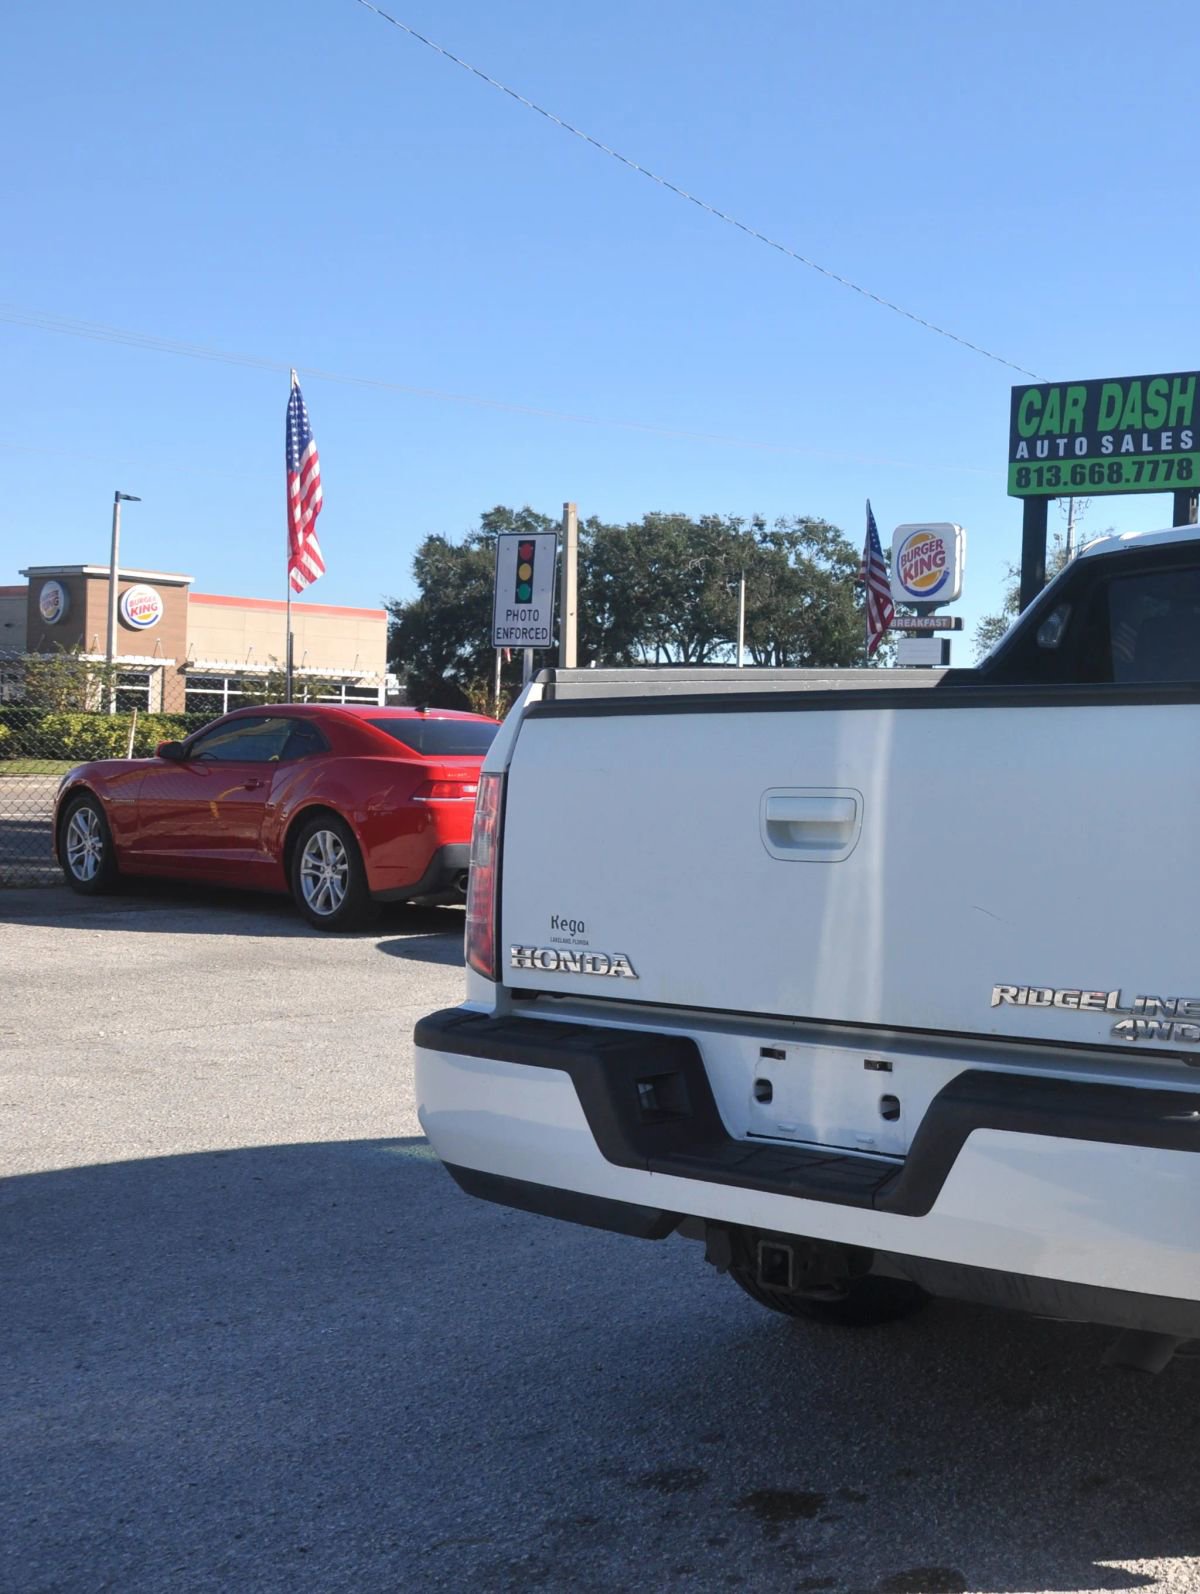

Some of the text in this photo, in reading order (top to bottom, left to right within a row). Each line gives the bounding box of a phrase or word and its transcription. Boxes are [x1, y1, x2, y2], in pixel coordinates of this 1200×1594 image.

[1017, 376, 1196, 438] CAR DASH
[1015, 430, 1193, 459] AUTO SALES
[1015, 458, 1193, 489] 813.668.7778
[900, 538, 944, 568] BURGER
[902, 550, 946, 586] KING
[130, 602, 158, 616] KING
[505, 609, 540, 622] PHOTO
[890, 618, 948, 628] BREAKFAST
[496, 627, 548, 640] ENFORCED
[510, 944, 640, 980] HONDA
